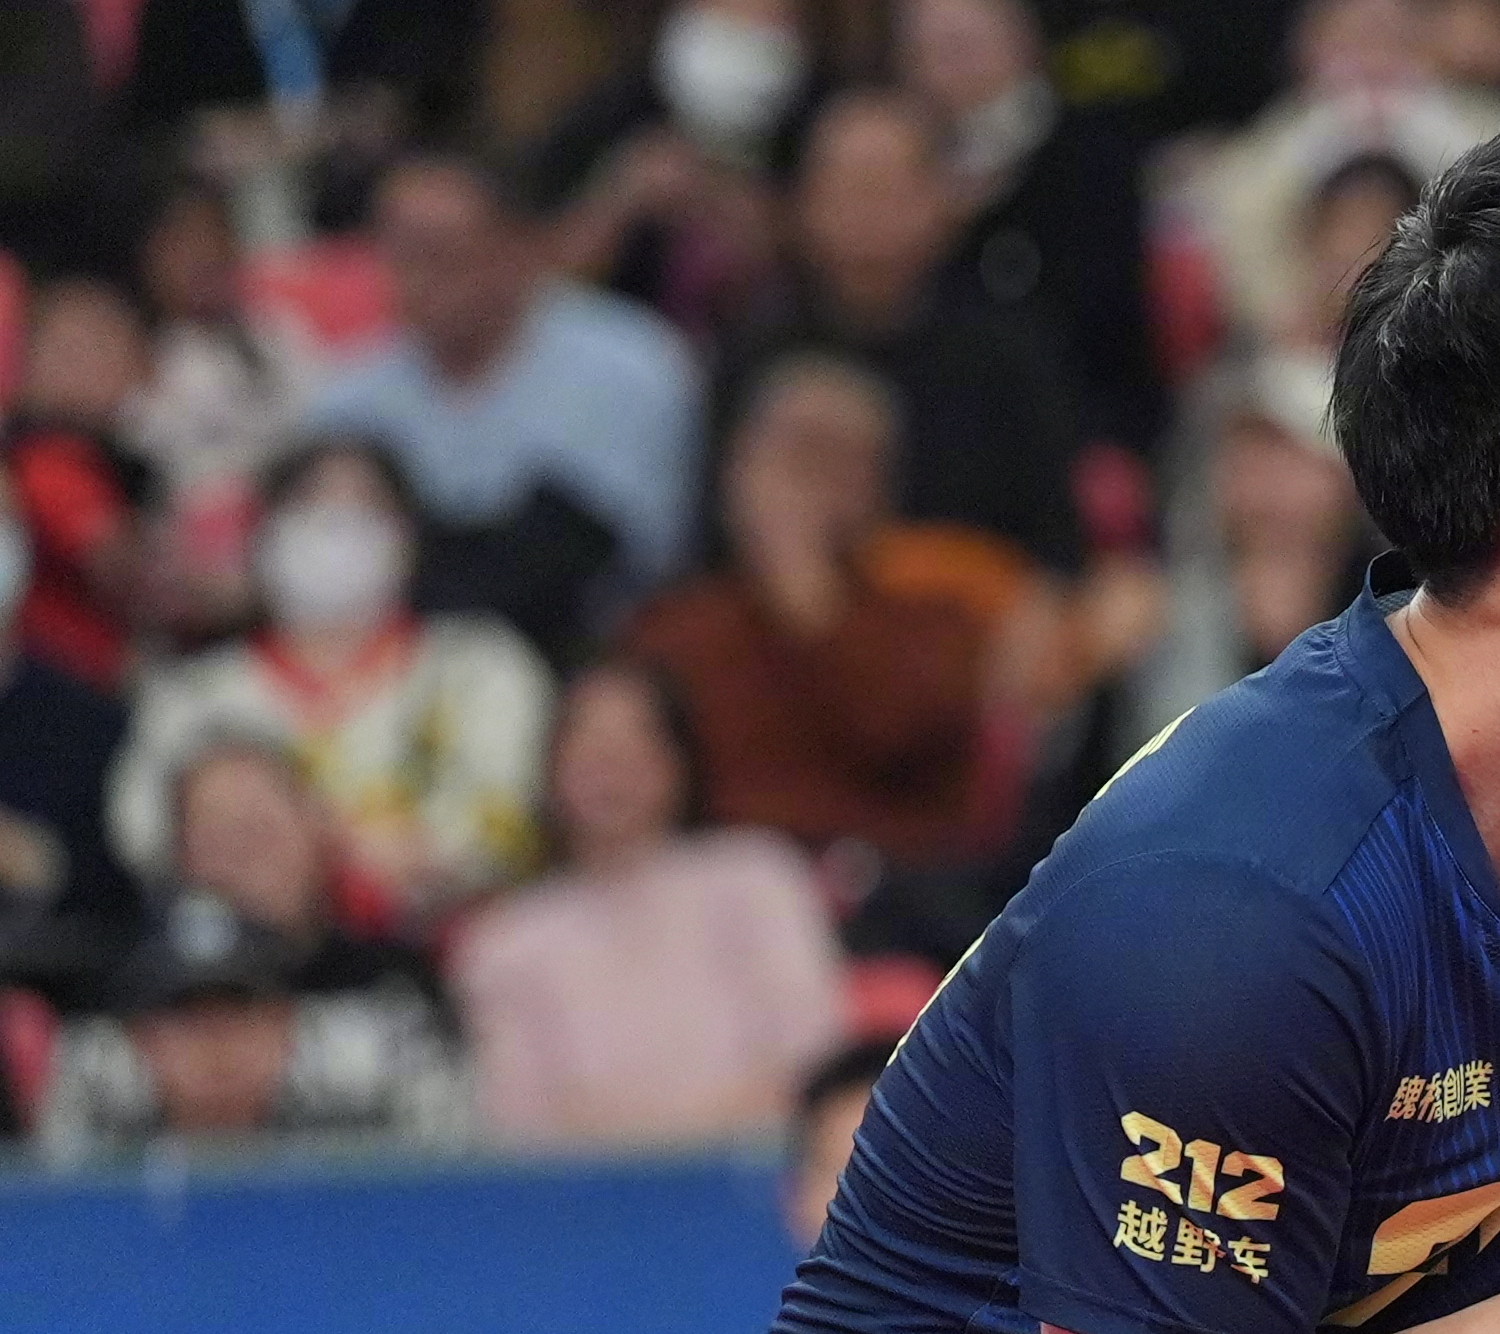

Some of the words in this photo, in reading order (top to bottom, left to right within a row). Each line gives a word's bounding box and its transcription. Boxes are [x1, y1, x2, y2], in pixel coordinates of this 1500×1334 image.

[1384, 1060, 1494, 1123] 魏橋創業
[1120, 1110, 1284, 1221] 212
[1113, 1198, 1272, 1284] 越野车
